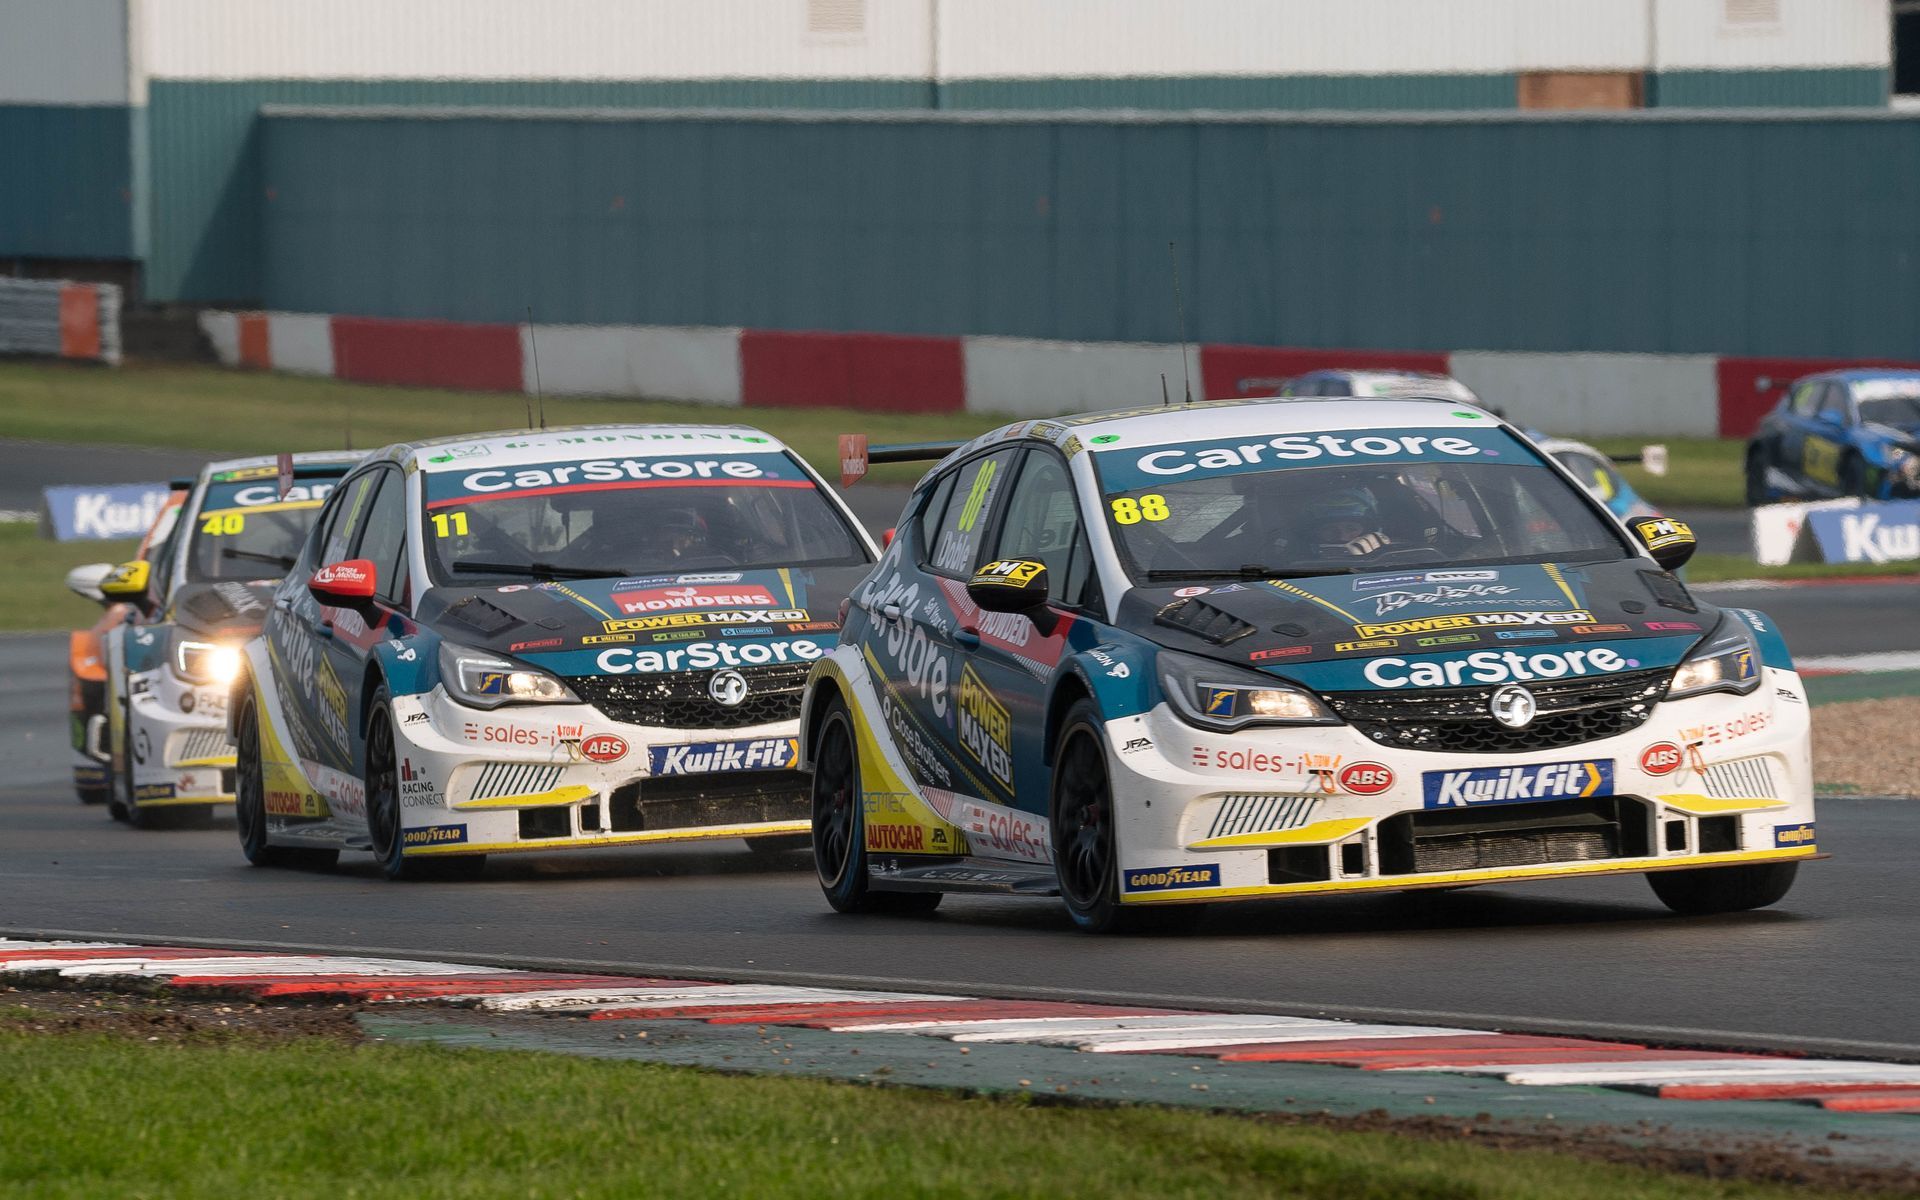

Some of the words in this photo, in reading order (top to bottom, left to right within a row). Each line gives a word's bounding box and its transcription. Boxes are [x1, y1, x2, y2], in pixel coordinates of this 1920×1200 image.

[958, 459, 997, 531] 88
[1111, 494, 1171, 525] 88
[202, 513, 245, 536] 40
[432, 512, 469, 538] 11
[978, 561, 1038, 577] PMR
[624, 594, 771, 613] HOWDENS
[608, 614, 705, 631] POWER
[707, 610, 803, 622] MAXED
[1362, 616, 1474, 637] POWER
[1475, 611, 1588, 625] MAXED
[404, 712, 430, 723] JFA
[961, 671, 1010, 752] POWER
[484, 723, 555, 747] sales-i
[563, 726, 577, 736] TOW
[588, 741, 622, 755] ABS
[893, 706, 914, 748] Close
[914, 730, 951, 788] Brothers
[960, 708, 1011, 784] MAXED
[1123, 737, 1153, 751] JFA
[1217, 748, 1303, 775] sales-i
[1346, 770, 1389, 785] ABS
[1644, 749, 1678, 767] ABS
[402, 781, 434, 794] RACING
[403, 793, 445, 808] CONNECT
[868, 824, 923, 850] AUTOCAR
[1131, 867, 1211, 888] GOODYEAR
